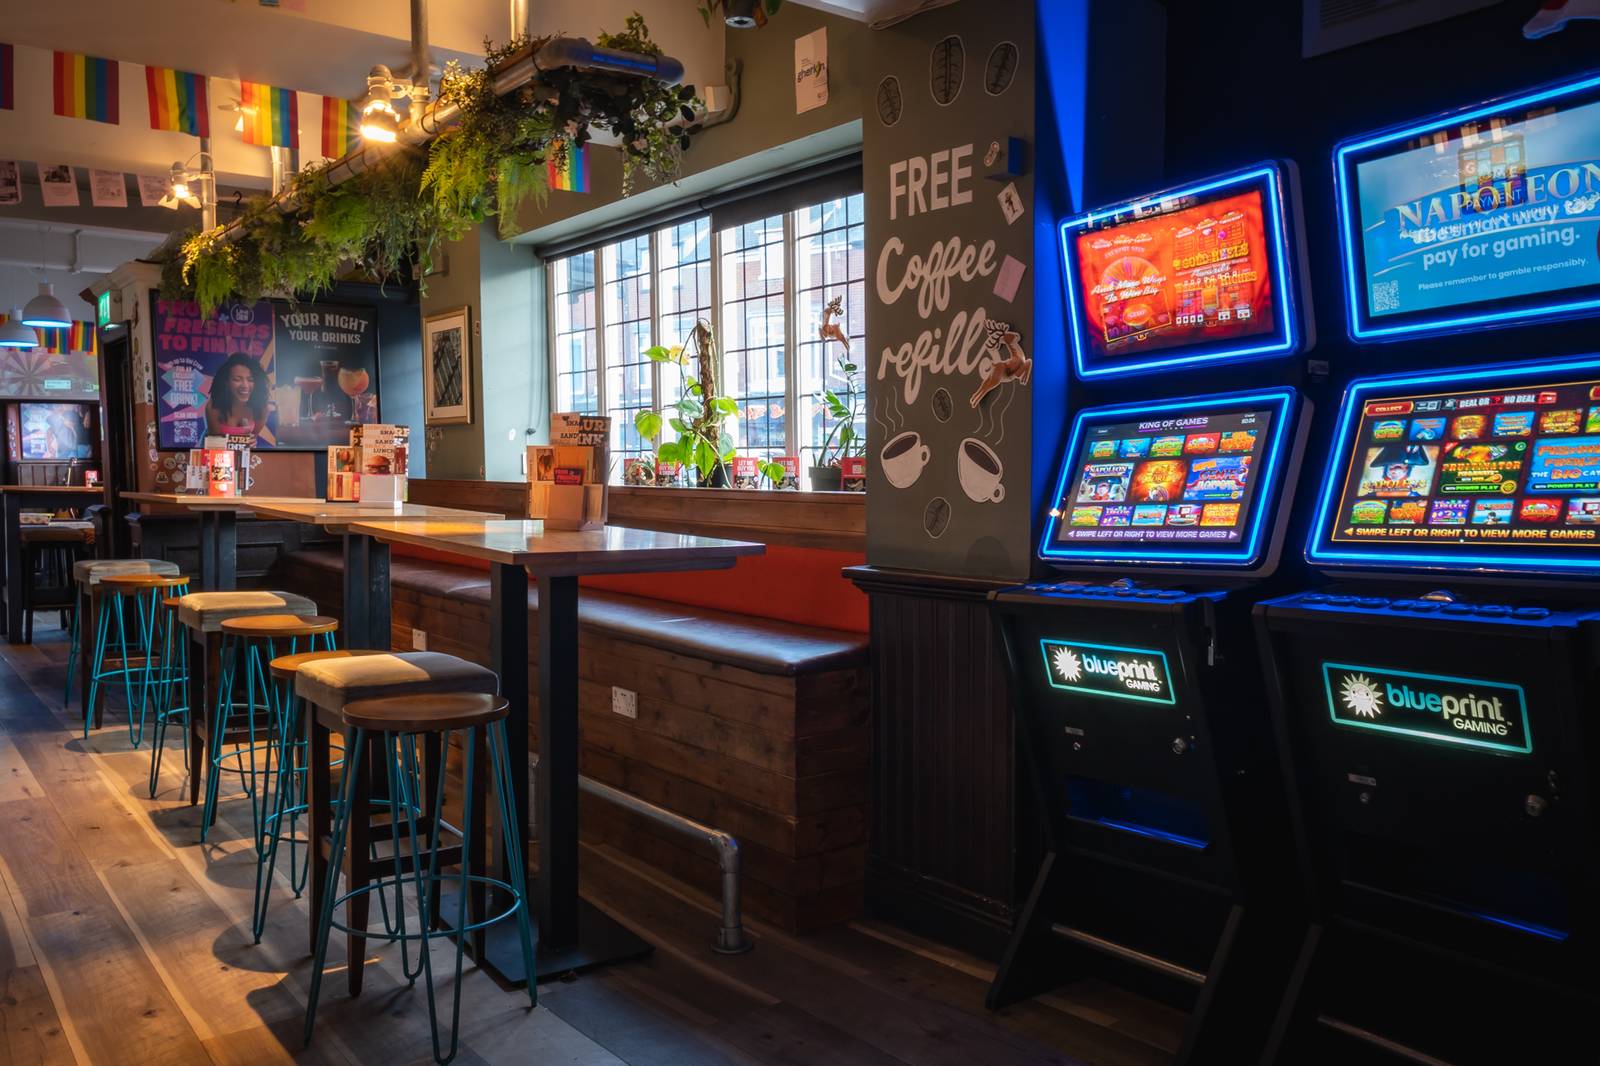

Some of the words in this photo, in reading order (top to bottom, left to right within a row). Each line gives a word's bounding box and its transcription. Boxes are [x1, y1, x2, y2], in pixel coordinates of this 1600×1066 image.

[890, 143, 973, 220] FREE
[1395, 162, 1600, 233] NAPOLEON
[1466, 188, 1522, 211] PAYMENT
[1423, 244, 1458, 271] pay
[1462, 241, 1489, 259] for
[1492, 226, 1581, 258] gaming.
[876, 236, 998, 319] Coffee
[1418, 281, 1443, 291] Please
[1444, 273, 1487, 287] remember
[1488, 272, 1497, 281] to
[1498, 266, 1532, 281] gamble
[163, 318, 269, 340] FRESHERS
[280, 312, 320, 328] YOUR
[324, 313, 369, 333] NIGHT
[158, 334, 188, 351] TO
[191, 336, 264, 357] FINALS
[289, 330, 319, 341] YOUR
[322, 331, 361, 345] DRINKS
[174, 380, 193, 392] FREE
[1459, 398, 1478, 408] DEAL
[1478, 397, 1490, 406] OR
[1503, 395, 1515, 404] NO
[1516, 394, 1536, 404] DEAL
[1139, 421, 1160, 430] KING
[1161, 419, 1175, 428] OF
[1175, 417, 1209, 426] GAMES
[1441, 461, 1521, 473] FRUITINATOR
[1551, 468, 1582, 480] BIG
[1076, 530, 1096, 538] SWIPE
[1097, 530, 1114, 538] LEFT
[1114, 530, 1123, 538] OR
[1124, 530, 1145, 538] RIGHT
[1145, 530, 1155, 538] TO
[1156, 530, 1176, 538] VIEW
[1176, 530, 1200, 538] MORE
[1200, 530, 1227, 539] GAMES
[1355, 528, 1388, 537] SWIPE
[1388, 528, 1412, 537] LEFT
[1413, 528, 1428, 537] OR
[1430, 529, 1463, 538] RIGHT
[1463, 529, 1479, 538] TO
[1480, 529, 1511, 538] VIEW
[1512, 529, 1547, 539] MORE
[1549, 529, 1597, 540] GAMES
[1081, 653, 1158, 682] blueprint
[1126, 679, 1161, 692] GAMING
[1386, 683, 1505, 721] blueprint
[1453, 717, 1508, 736] GAMING
